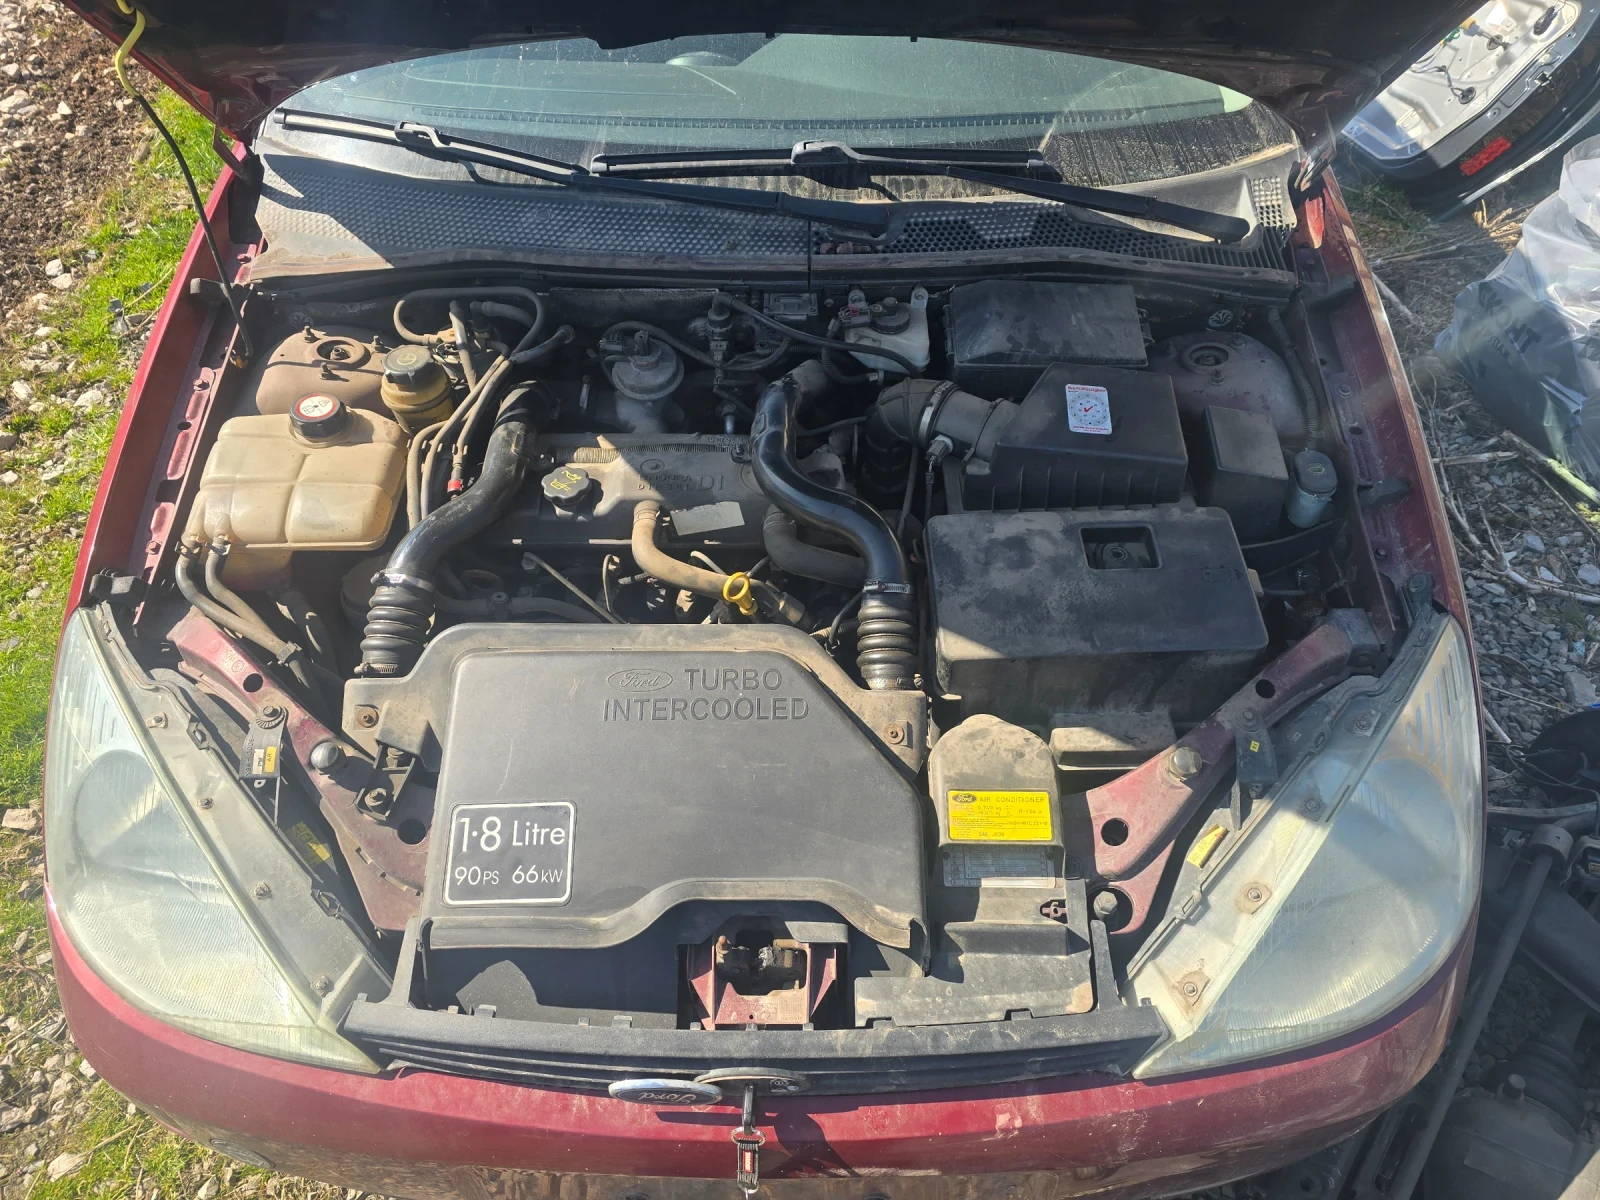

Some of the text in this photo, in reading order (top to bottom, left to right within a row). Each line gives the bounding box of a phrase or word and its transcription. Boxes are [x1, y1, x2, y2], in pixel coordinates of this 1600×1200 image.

[698, 475, 723, 490] DI
[684, 668, 782, 690] TURBO
[603, 697, 809, 721] INTERCOOLED
[512, 820, 565, 846] Litre
[638, 1091, 697, 1105] Ford
